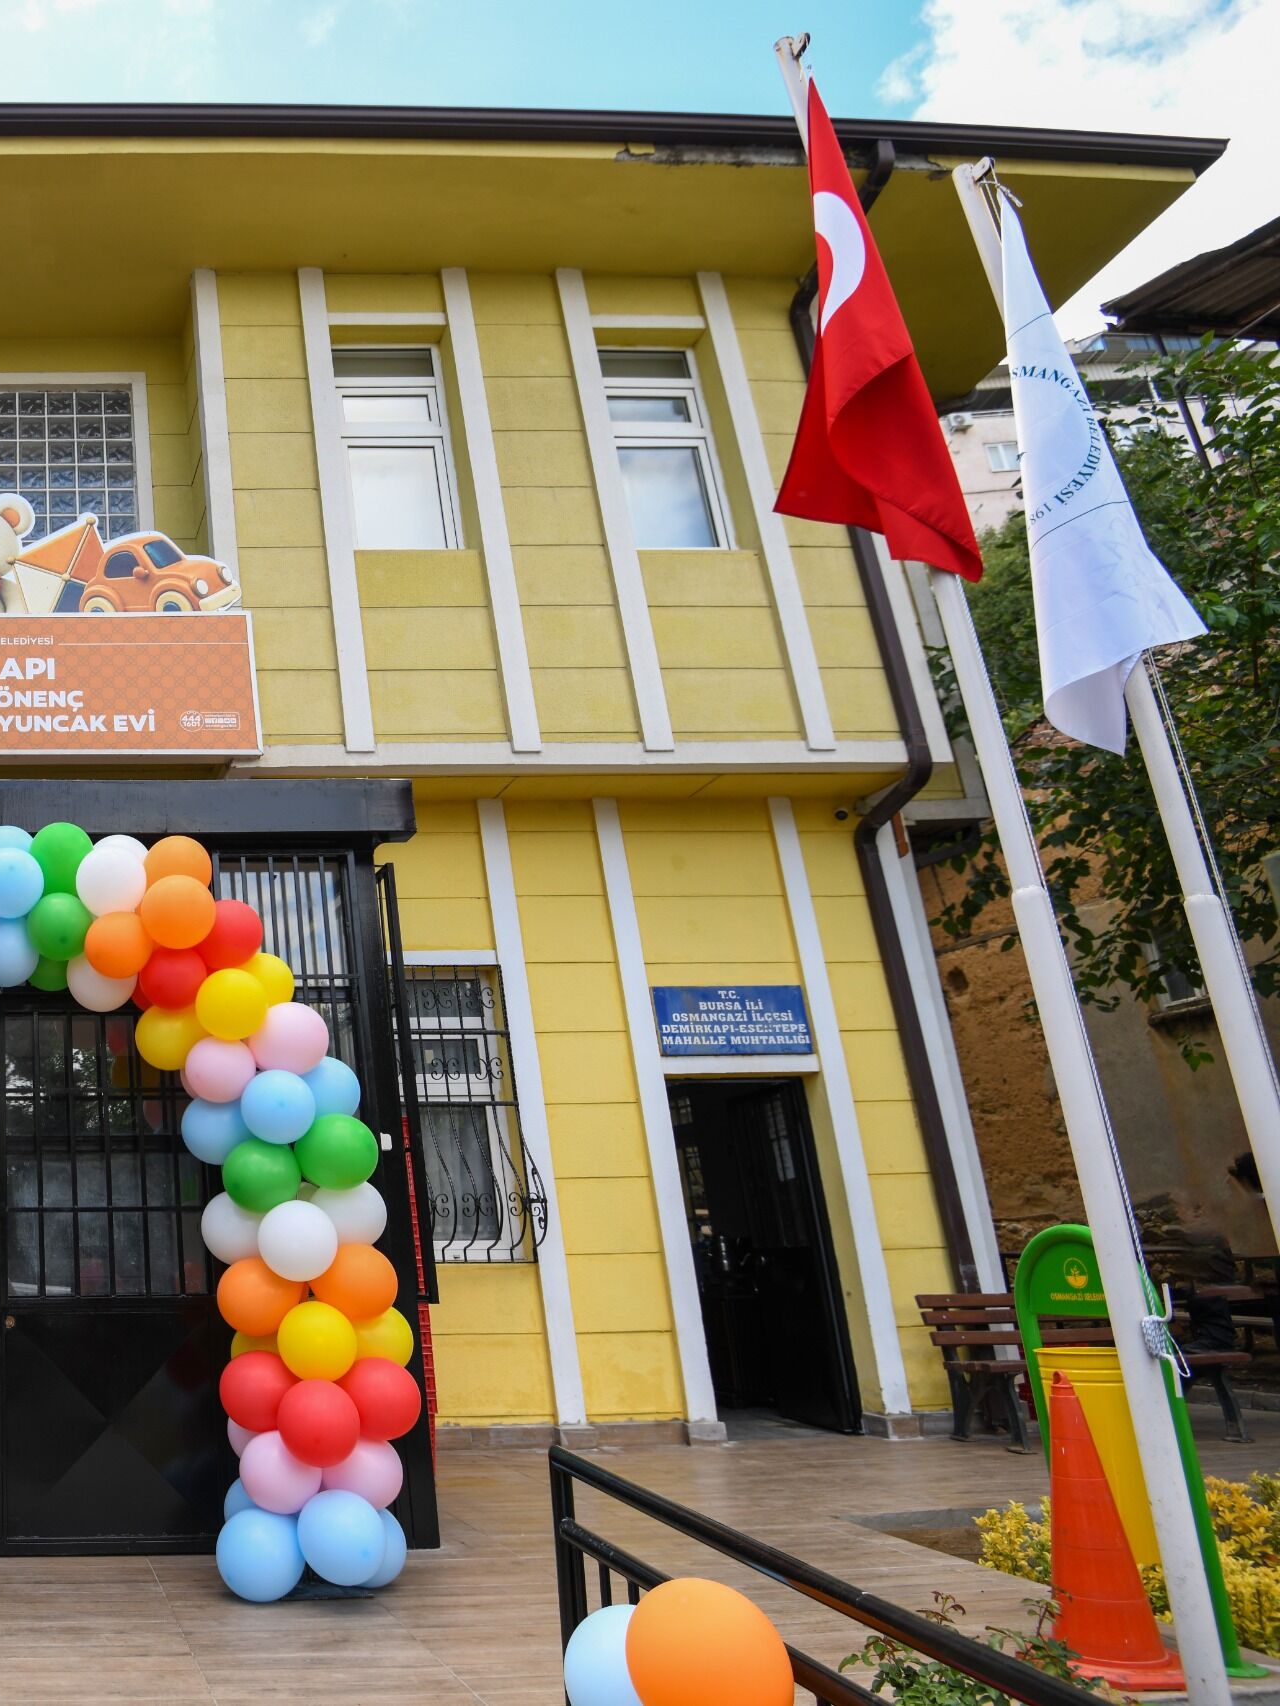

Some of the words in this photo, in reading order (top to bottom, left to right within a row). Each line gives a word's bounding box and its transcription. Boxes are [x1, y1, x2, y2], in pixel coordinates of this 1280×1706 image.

[113, 708, 156, 732] EVİ
[717, 990, 740, 999] T.C.
[698, 1001, 742, 1011] BURSA
[745, 999, 764, 1011] İLİ
[672, 1010, 748, 1022] OSMANGAZİ
[751, 1009, 793, 1023] İLÇESİ
[662, 1035, 727, 1045] MAHALLE
[730, 1034, 811, 1046] MUHTARLIĞI
